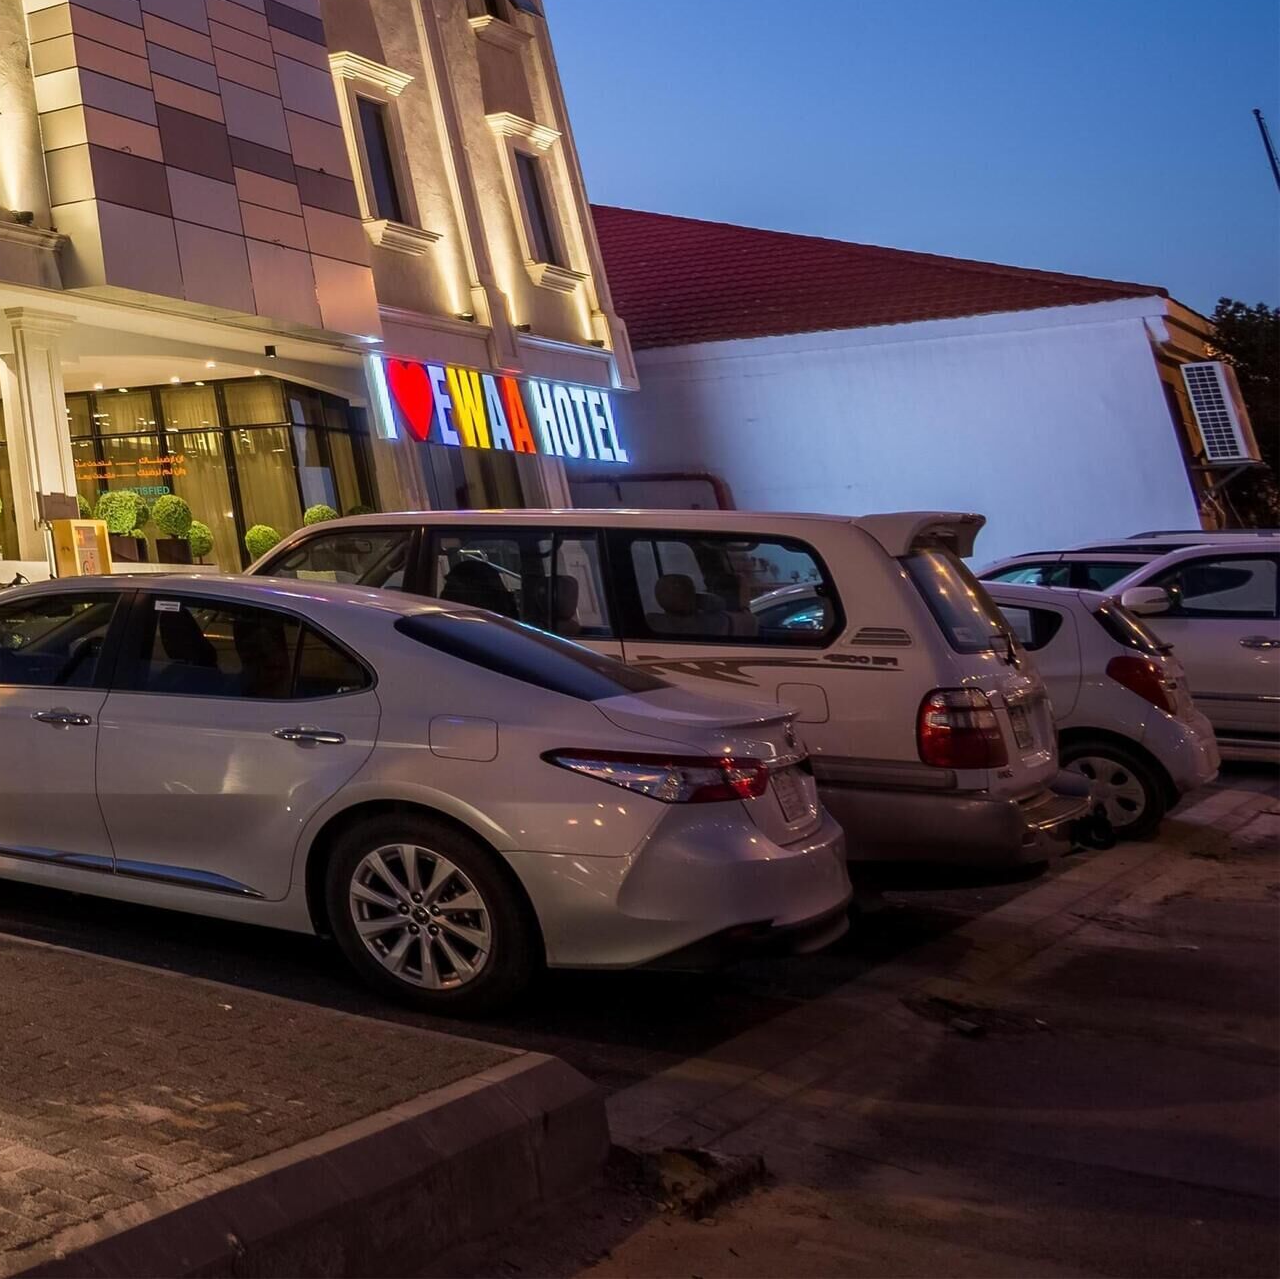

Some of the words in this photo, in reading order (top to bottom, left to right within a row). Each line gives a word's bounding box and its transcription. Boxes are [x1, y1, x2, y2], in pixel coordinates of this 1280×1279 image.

[364, 352, 398, 439] I
[425, 363, 537, 454] EWAA
[529, 379, 630, 463] HOTEL
